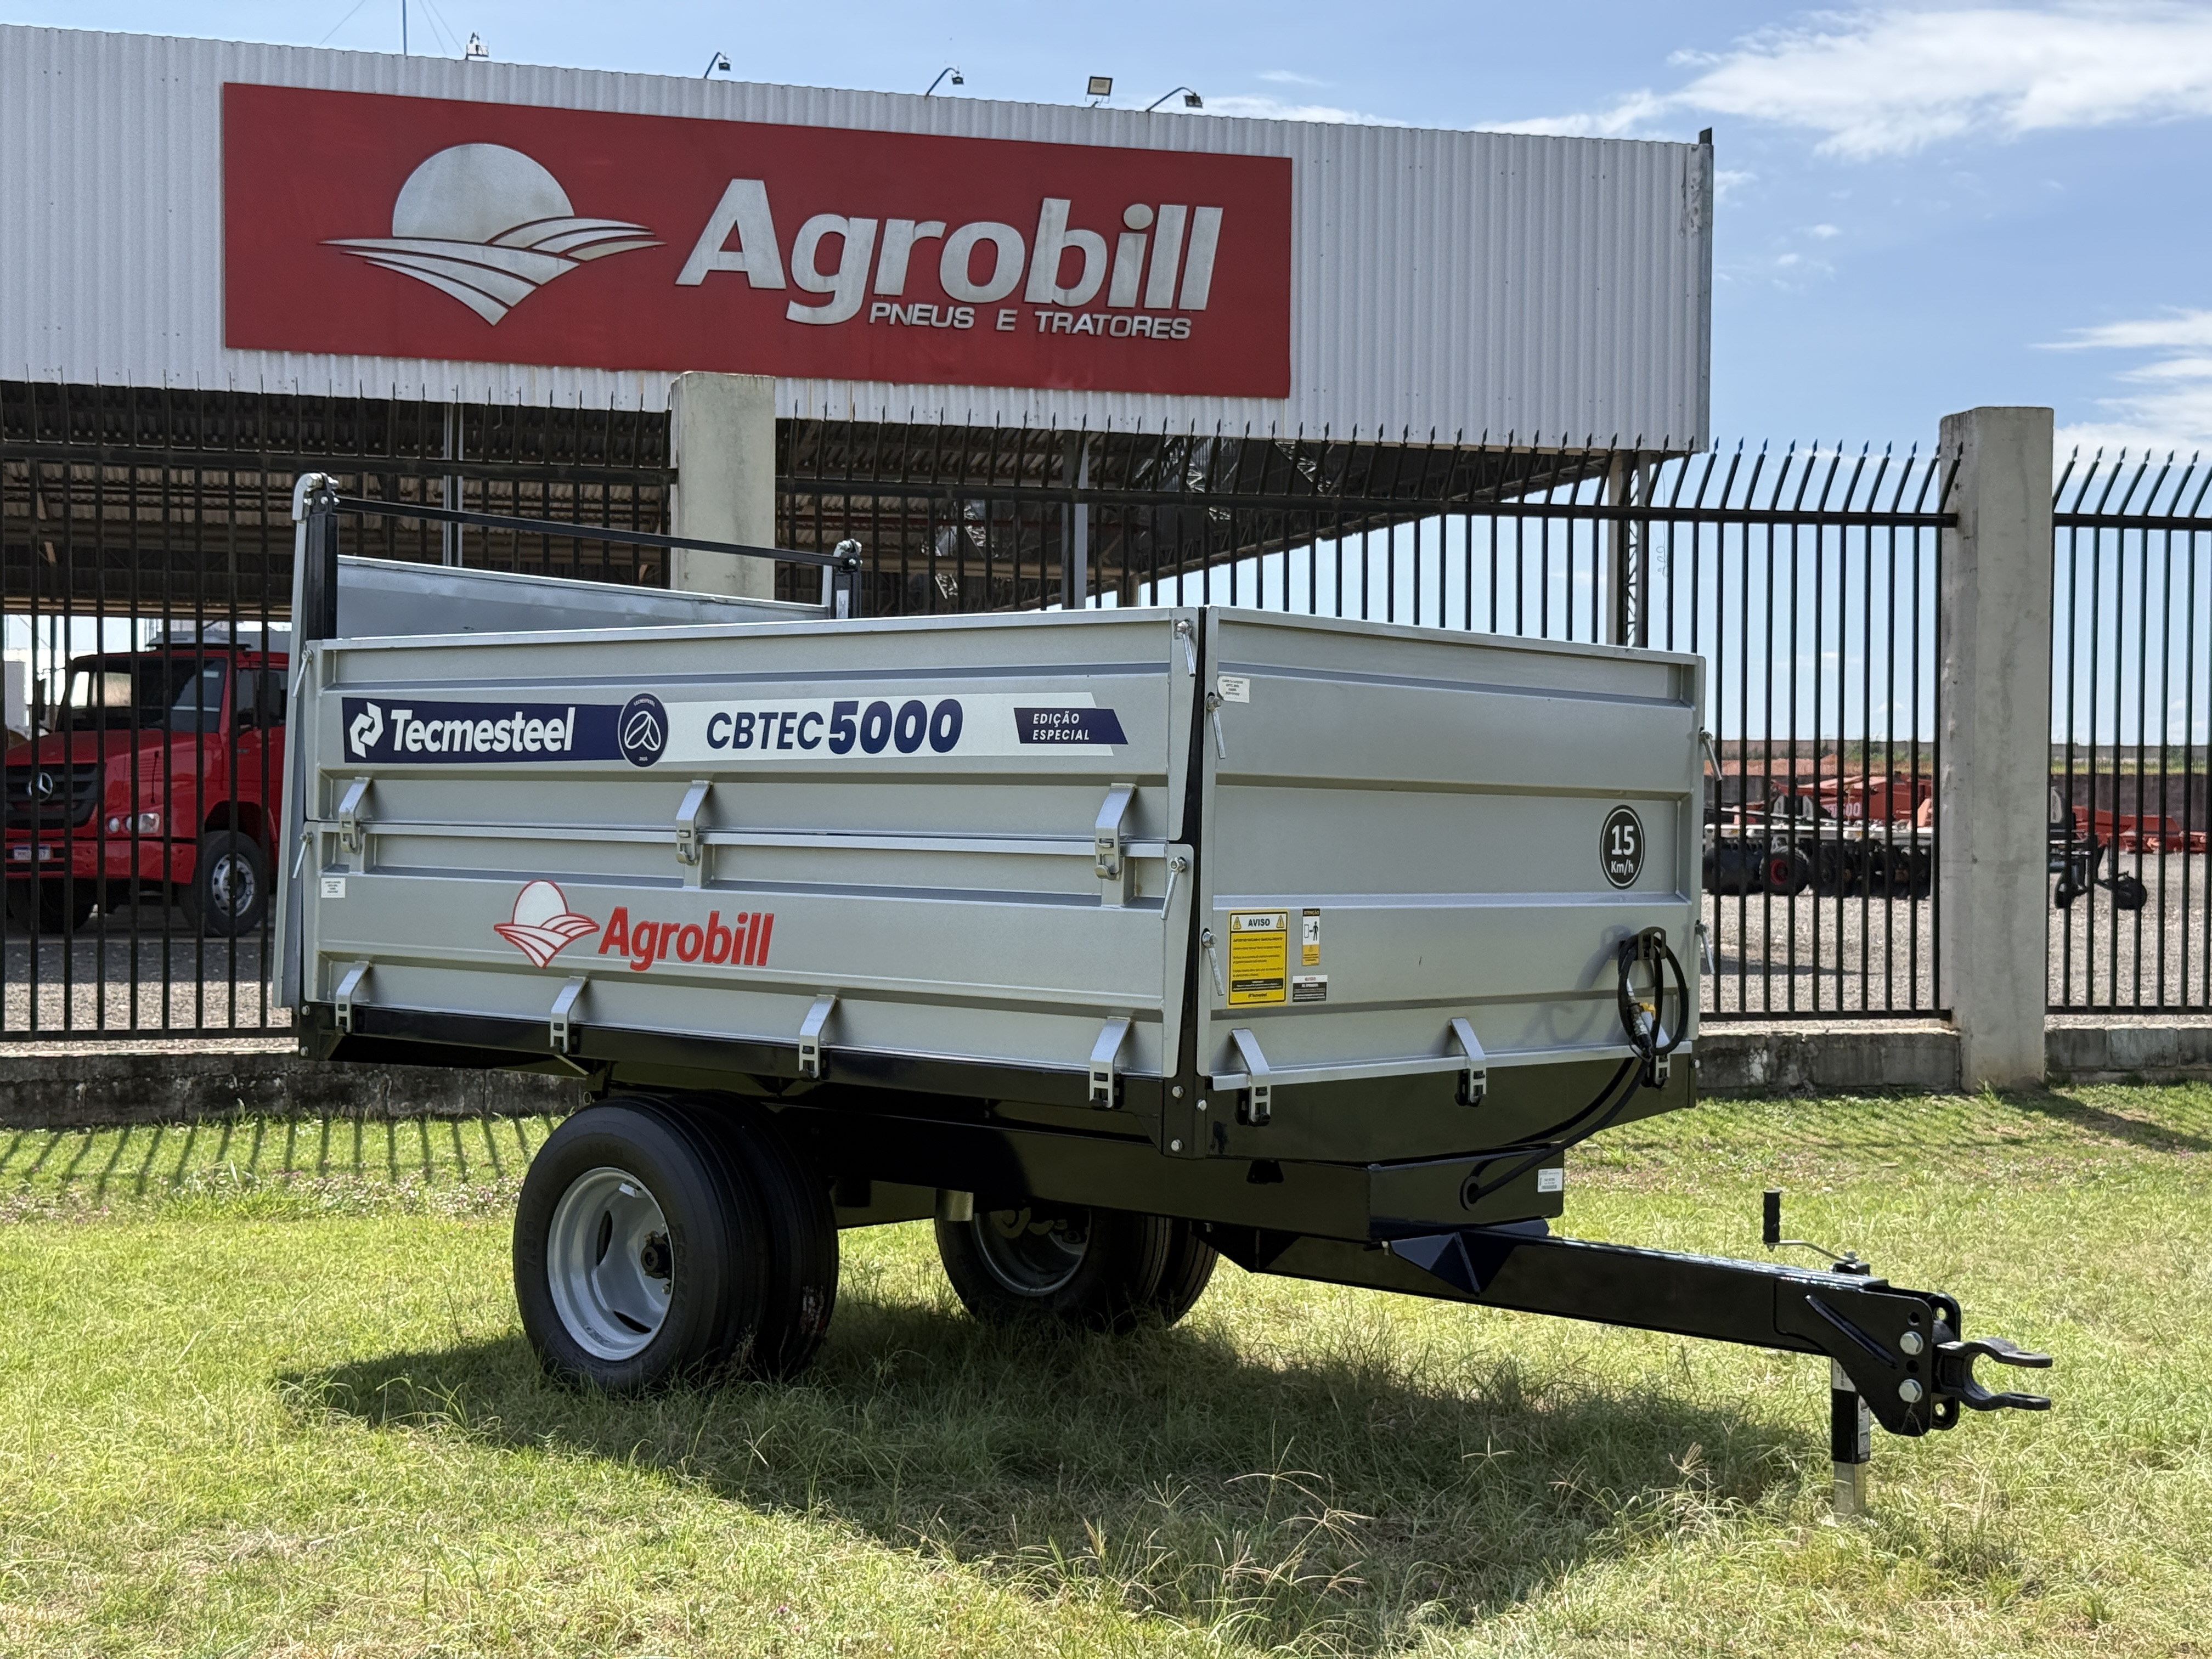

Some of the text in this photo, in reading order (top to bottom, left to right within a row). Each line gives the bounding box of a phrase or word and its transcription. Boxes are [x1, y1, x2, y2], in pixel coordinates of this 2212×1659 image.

[675, 178, 1223, 325] Agrobill
[869, 302, 1192, 340] PNEUS E TRATORES
[391, 707, 576, 752] Tecmesteel
[1033, 710, 1080, 727] EDIÇÃO
[1032, 730, 1090, 741] ESPECIAL
[1611, 825, 1634, 855] 15
[1611, 859, 1634, 876] Km/h
[1248, 918, 1271, 927] AVISO
[599, 906, 775, 971] Agrobill
